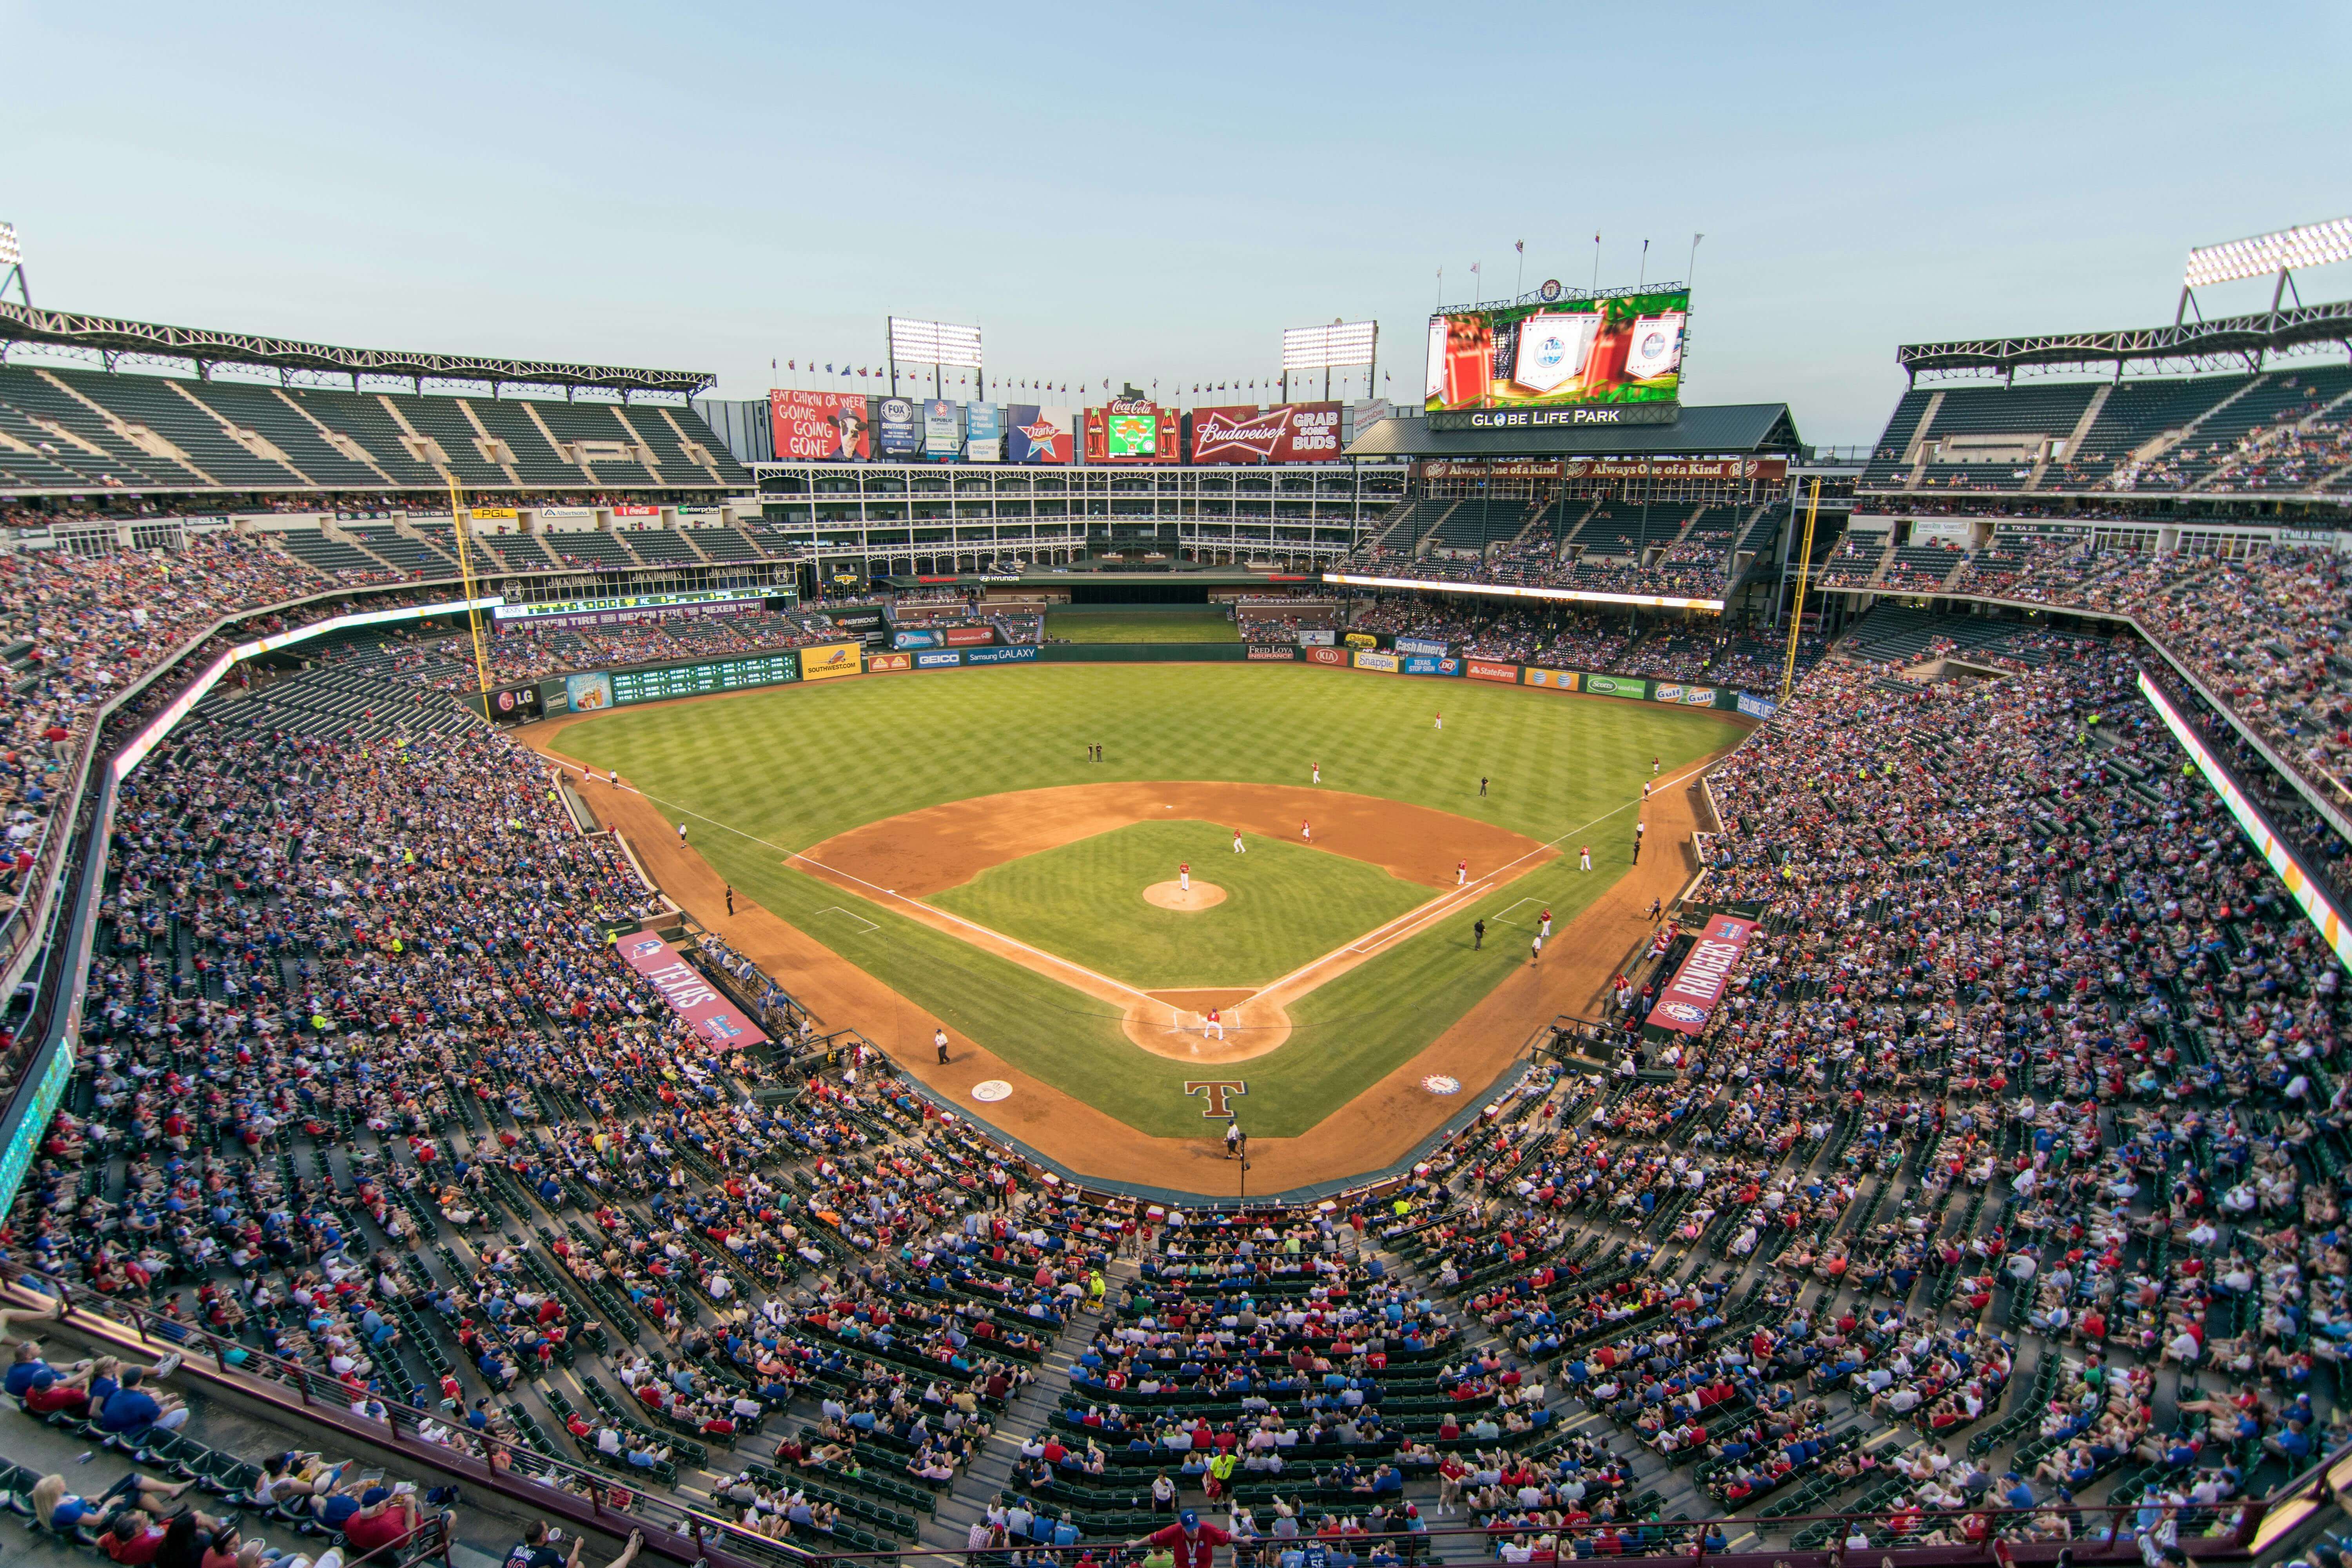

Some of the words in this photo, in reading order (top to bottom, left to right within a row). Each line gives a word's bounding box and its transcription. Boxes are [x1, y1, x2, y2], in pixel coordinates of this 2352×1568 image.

[1547, 286, 1554, 295] T
[773, 391, 790, 402] EAT
[793, 391, 822, 407] CHIKIN
[826, 394, 838, 408] OR
[840, 396, 865, 410] WEER
[888, 405, 905, 414] FOX
[1112, 400, 1151, 414] Coca-Cola
[779, 405, 816, 421] GOING
[1355, 408, 1384, 426] SportsDay
[1472, 412, 1528, 426] GLOBE
[1533, 412, 1569, 424] LIFE
[1573, 410, 1620, 423] PARK
[1293, 412, 1337, 427] GRAB
[793, 421, 833, 438] GOING
[1027, 425, 1055, 438] Ozarka
[1197, 423, 1286, 443] Budweiser
[1300, 426, 1329, 436] SOME
[790, 437, 830, 457] GONE
[1292, 436, 1336, 450] BUDS
[1427, 467, 1445, 476] Pepper
[1449, 465, 1486, 476] Always
[1510, 464, 1521, 474] of
[1530, 465, 1557, 474] Kind
[1592, 463, 1636, 476] Always
[1664, 464, 1679, 474] of
[1688, 464, 1722, 474] Kind
[633, 571, 653, 582] JACK
[709, 567, 727, 577] JACK
[548, 577, 569, 587] JACK
[702, 603, 737, 614] NEXEN
[569, 616, 597, 625] TIRE
[919, 655, 959, 664] GEICO
[999, 649, 1034, 659] GALAXY
[1319, 652, 1335, 660] KIA
[1359, 655, 1393, 669] Snapple
[808, 663, 856, 673] SOUTHWEST.COM
[1592, 680, 1613, 690] Scotts
[515, 690, 534, 705] LG
[1657, 689, 1681, 699] Gulf
[1689, 693, 1713, 702] Gulf
[1744, 697, 1760, 715] GLOBE
[1672, 940, 1738, 999] RANGERS
[647, 962, 717, 1009] TEXAS
[1431, 1079, 1450, 1088] T
[1184, 1080, 1248, 1119] T
[1304, 1329, 1312, 1337] 29
[1111, 1379, 1116, 1387] 11
[1187, 1514, 1193, 1523] T
[1571, 1517, 1588, 1526] HAMILTON
[514, 1545, 536, 1560] YOUNG
[1311, 1559, 1324, 1568] 56
